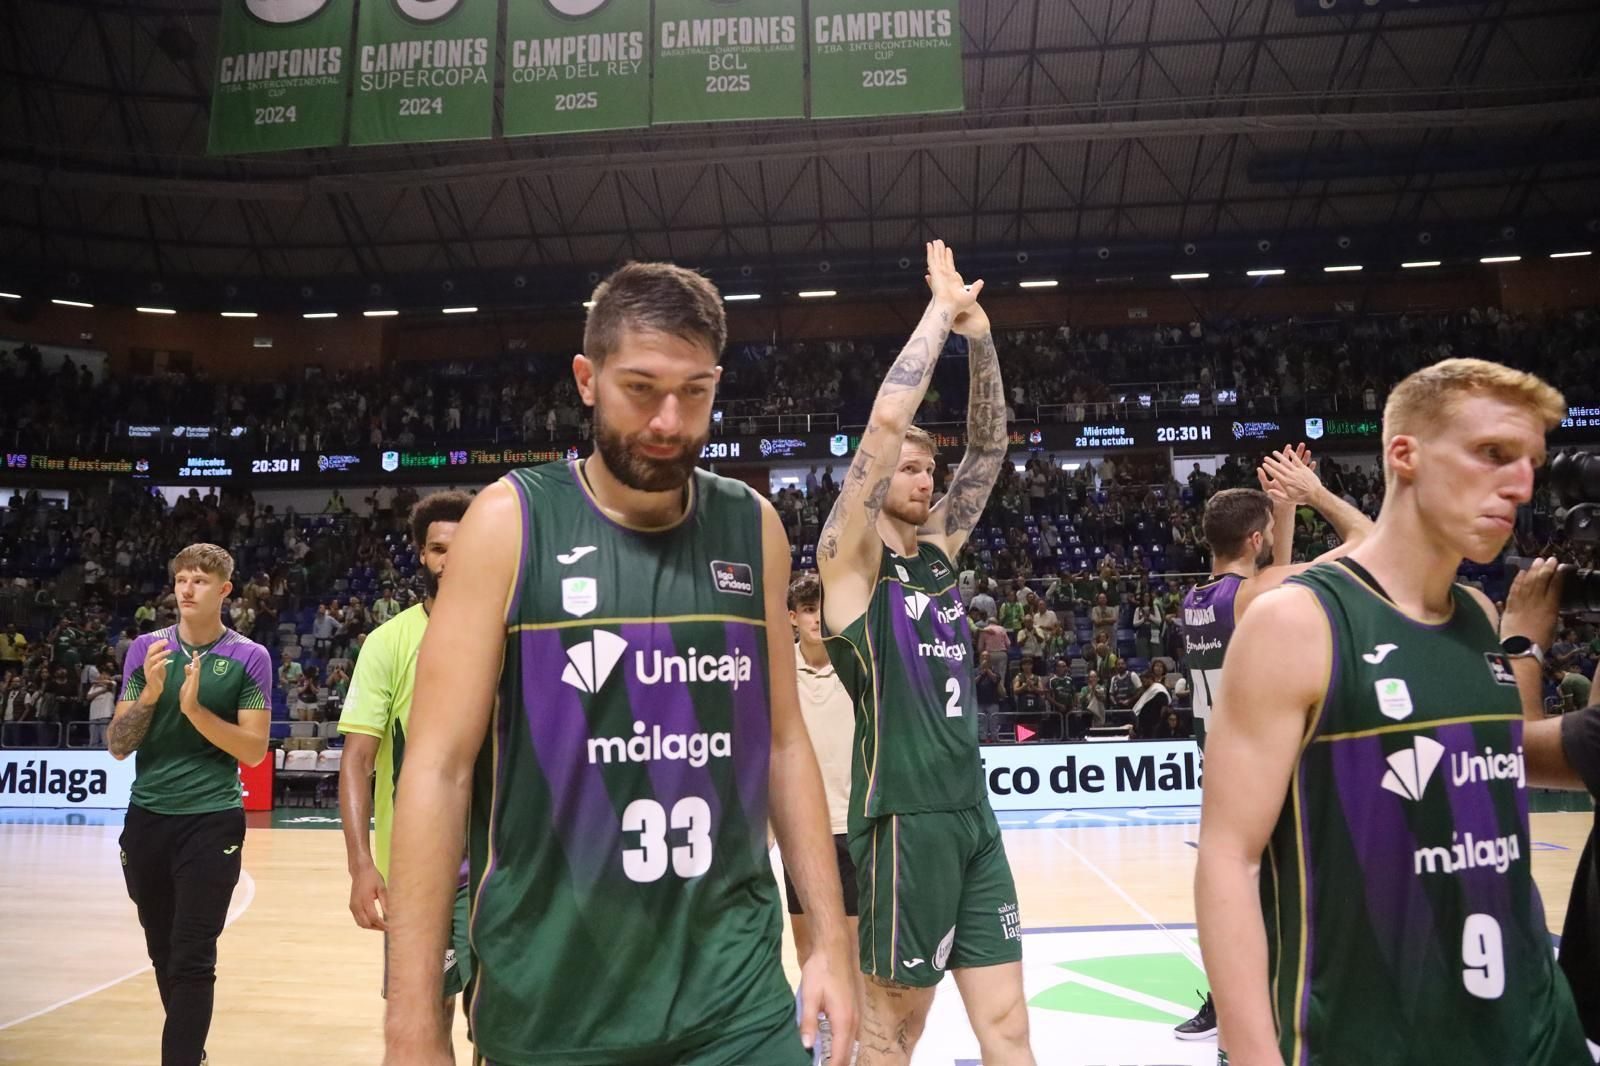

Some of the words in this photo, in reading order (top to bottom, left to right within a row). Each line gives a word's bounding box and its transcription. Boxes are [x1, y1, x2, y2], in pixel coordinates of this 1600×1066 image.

[661, 16, 796, 48] CAMPEONES
[815, 9, 952, 44] CAMPEONES
[360, 38, 488, 73] CAMPEONES
[512, 31, 643, 68] CAMPEONES
[817, 44, 842, 54] FIBA
[849, 39, 952, 52] INTERCONTINENTAL
[874, 50, 895, 60] CUP
[219, 46, 342, 84] CAMPEONES
[512, 66, 559, 83] COPA
[565, 63, 599, 79] DEL
[607, 60, 642, 76] REY
[708, 53, 747, 71] BCL
[360, 66, 489, 91] SUPERCOPA
[705, 75, 751, 93] 2025
[862, 68, 908, 88] 2025
[399, 97, 443, 116] 2024
[554, 91, 598, 111] 2025
[254, 105, 296, 125] 2024
[1084, 426, 1125, 436] Miércoles
[1576, 418, 1587, 427] de
[1089, 437, 1100, 446] de
[1101, 436, 1135, 446] octubre
[1157, 427, 1198, 441] 20:30
[1202, 426, 1211, 439] H
[450, 450, 467, 464] VS
[730, 443, 740, 456] H
[6, 453, 27, 468] VS
[187, 458, 225, 467] Miércoles
[252, 459, 288, 472] 20:30
[291, 459, 300, 471] H
[191, 468, 201, 476] de
[203, 467, 232, 476] octubre
[635, 646, 752, 691] Unicaja
[945, 677, 963, 718] 2
[1049, 755, 1105, 793] de
[1115, 752, 1203, 792] Mál
[621, 796, 713, 882] 33
[998, 903, 1016, 914] sabor
[1462, 913, 1505, 999] 9
